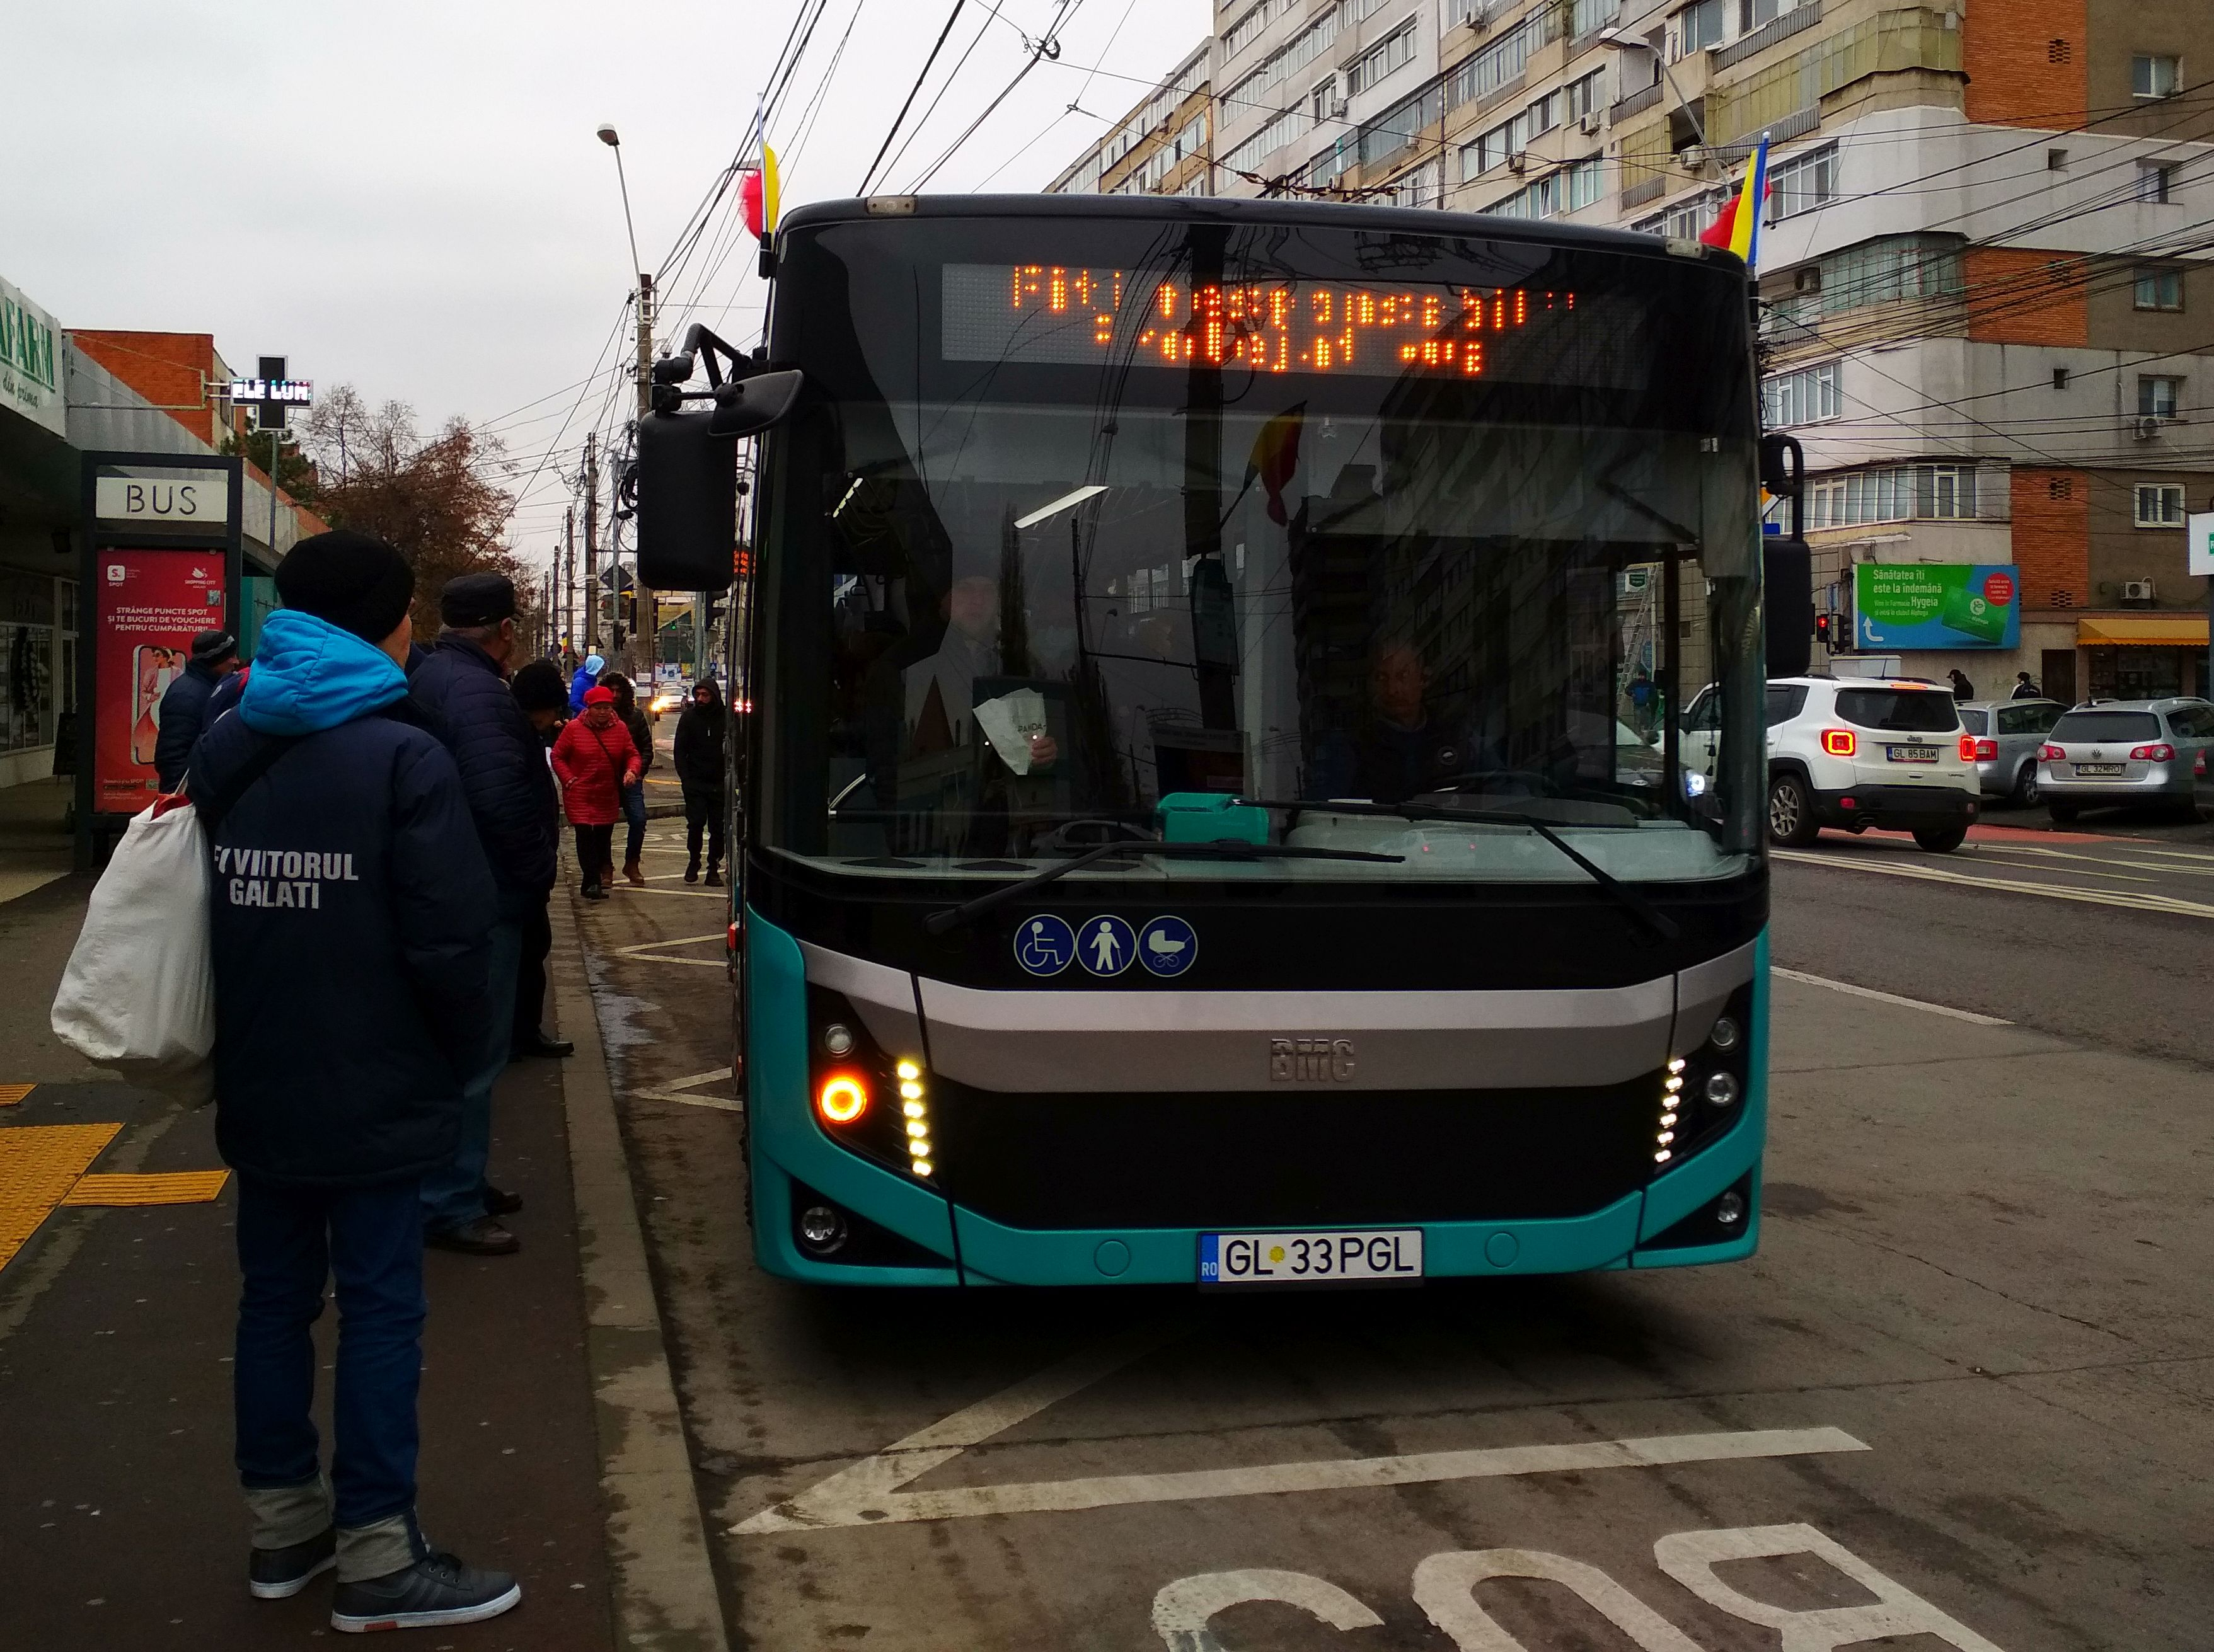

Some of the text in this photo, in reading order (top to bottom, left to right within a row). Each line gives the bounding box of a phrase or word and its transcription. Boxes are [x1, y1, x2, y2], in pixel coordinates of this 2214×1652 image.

[127, 485, 197, 515] BUS
[1873, 569, 1914, 580] Sănătatea
[1873, 583, 1942, 594] este la îndemână
[1911, 596, 1939, 609] Hygeia
[116, 606, 153, 614] STRÂNGE
[1894, 749, 1905, 758] GL
[233, 848, 359, 881] VIITORUL
[229, 878, 320, 909] GALATI
[1270, 1039, 1355, 1083] BMC
[1226, 1239, 1274, 1276] GL
[1201, 1262, 1218, 1276] RO
